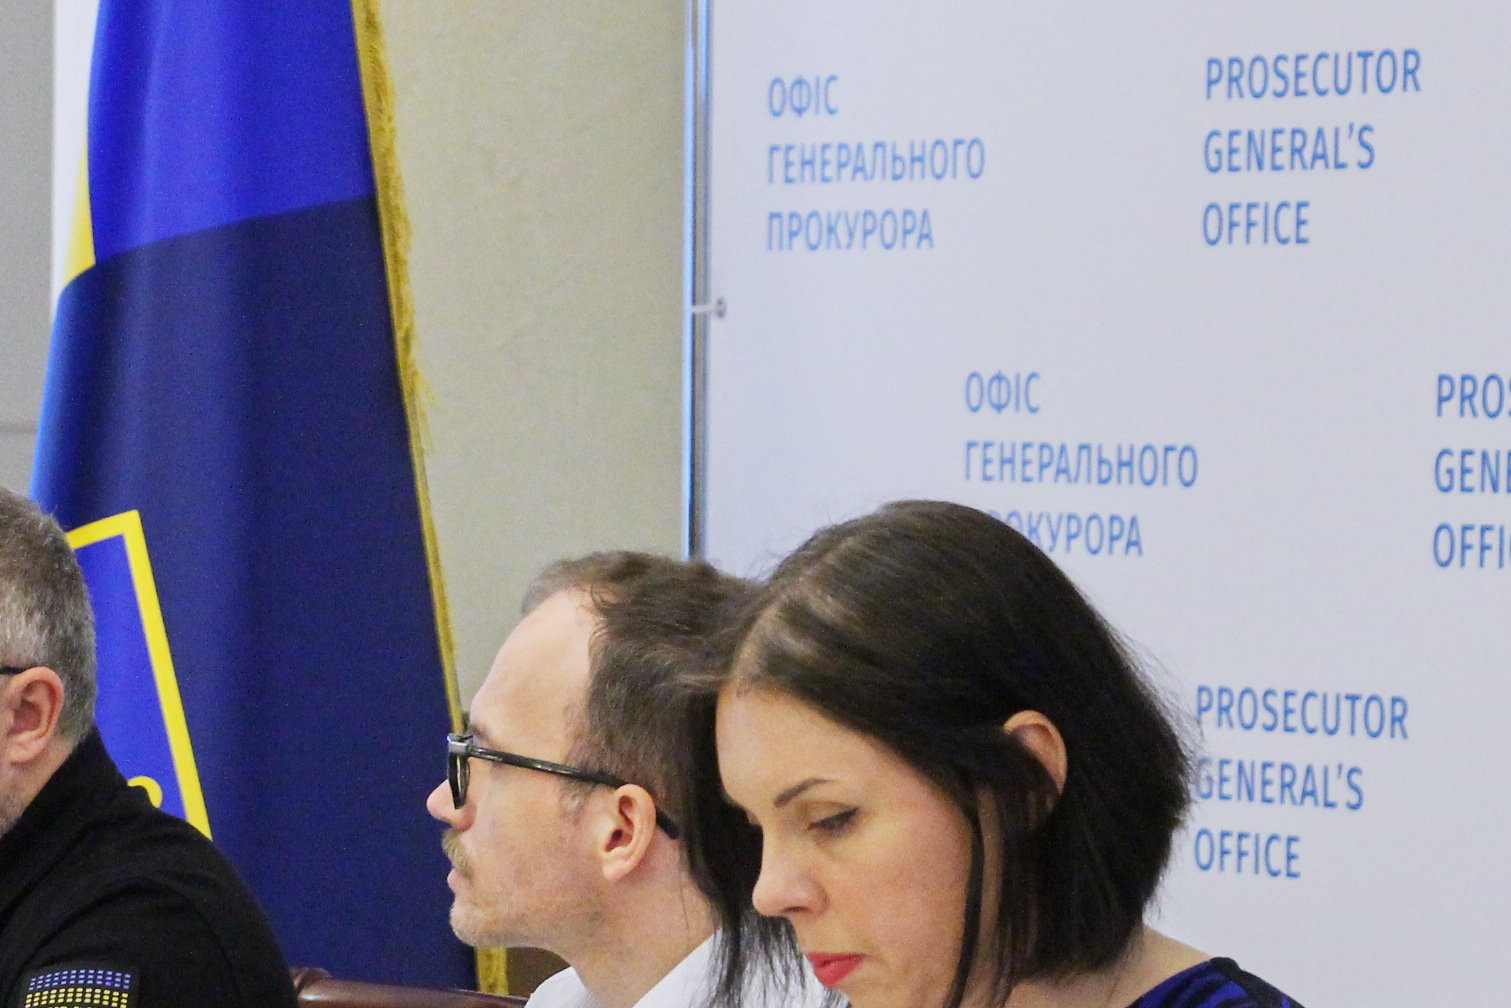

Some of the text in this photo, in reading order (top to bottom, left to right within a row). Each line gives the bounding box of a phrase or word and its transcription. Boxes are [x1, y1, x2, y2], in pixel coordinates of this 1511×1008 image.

[767, 74, 839, 118] ОФІС
[1206, 48, 1421, 100] PROSECUTOR
[767, 137, 985, 186] ГЕНЕРАЛЬНОГО
[767, 208, 934, 253] ПРОКУРОРА
[1202, 200, 1311, 248] OFFICE
[965, 371, 1040, 415] ОФІС
[1436, 373, 1511, 419] PRO
[965, 440, 1199, 489] ГЕНЕРАЛЬНОГО
[1433, 522, 1511, 569] OFFI
[1196, 684, 1409, 740] PROSECUTOR
[1193, 828, 1301, 879] OFFICE
